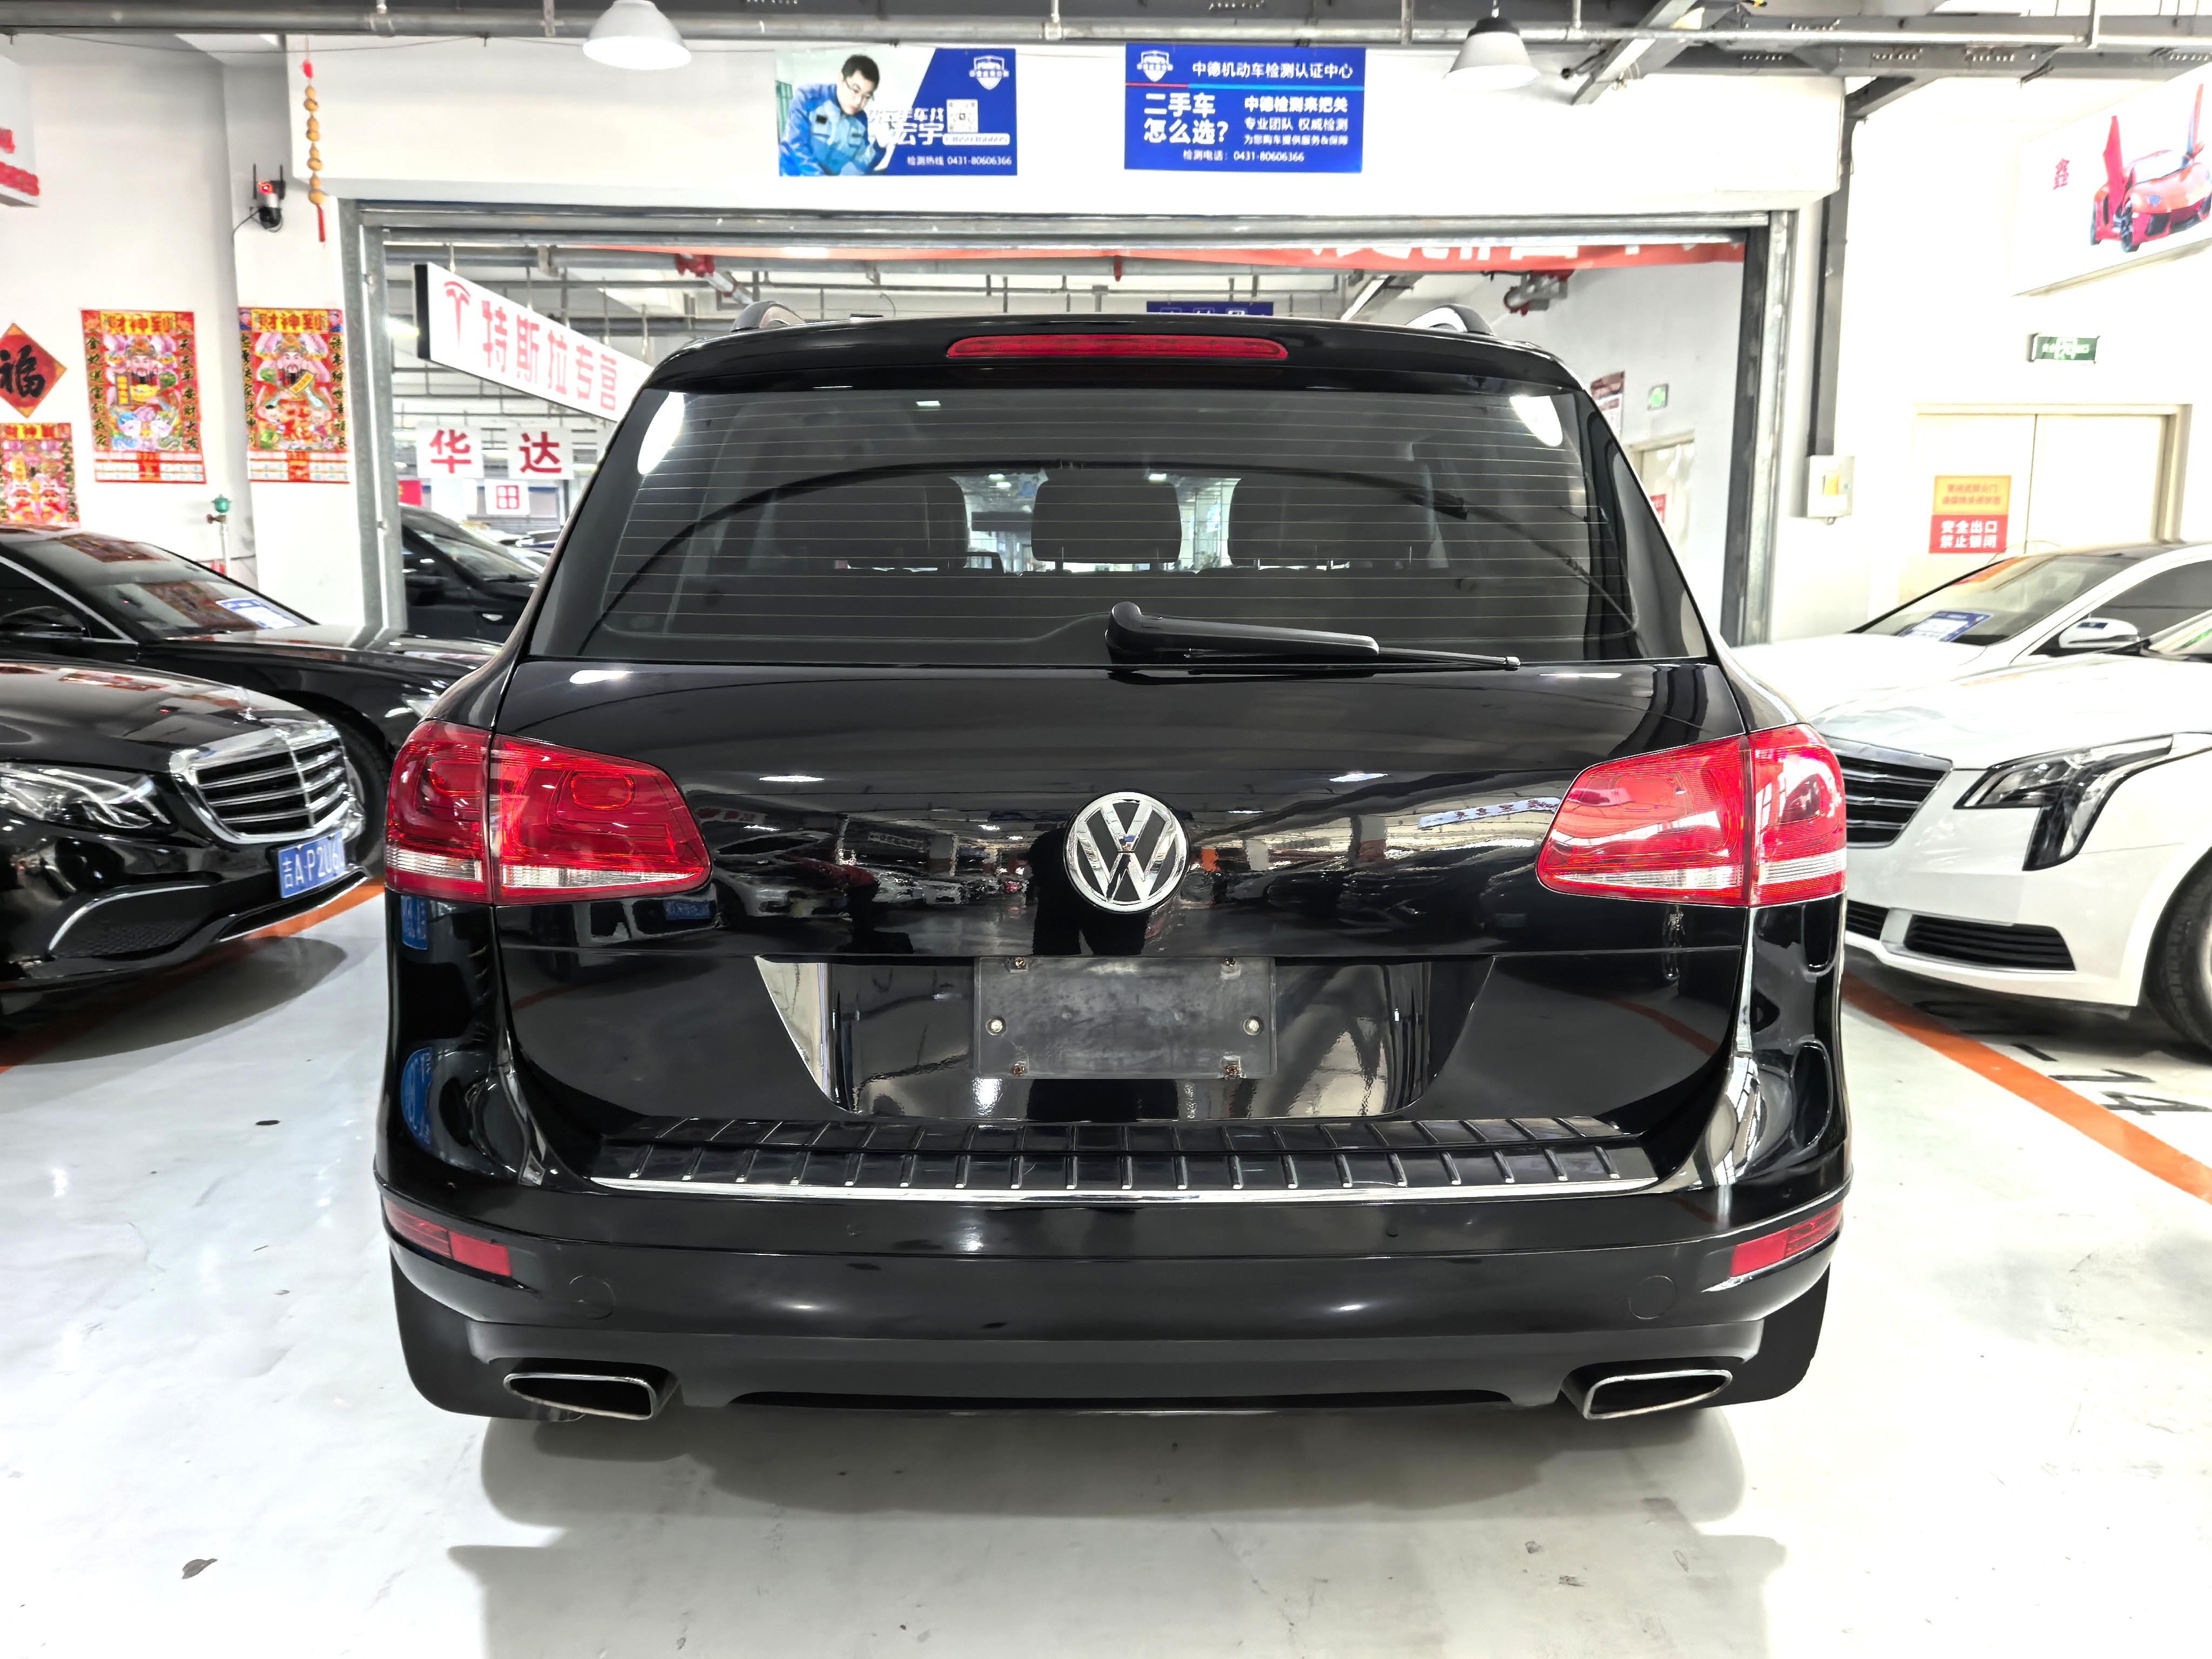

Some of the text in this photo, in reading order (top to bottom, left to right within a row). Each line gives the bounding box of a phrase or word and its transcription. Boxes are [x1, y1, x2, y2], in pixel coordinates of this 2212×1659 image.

[1192, 61, 1353, 79] 中德机动车检测认证中心
[1144, 92, 1216, 118] 二手车
[1244, 96, 1348, 113] 中德检测来把关
[1244, 117, 1348, 132] 专业团队 权威检测
[481, 300, 618, 411] 特斯拉专营
[429, 429, 562, 474] 华 达
[1941, 520, 1998, 534] 安全出口
